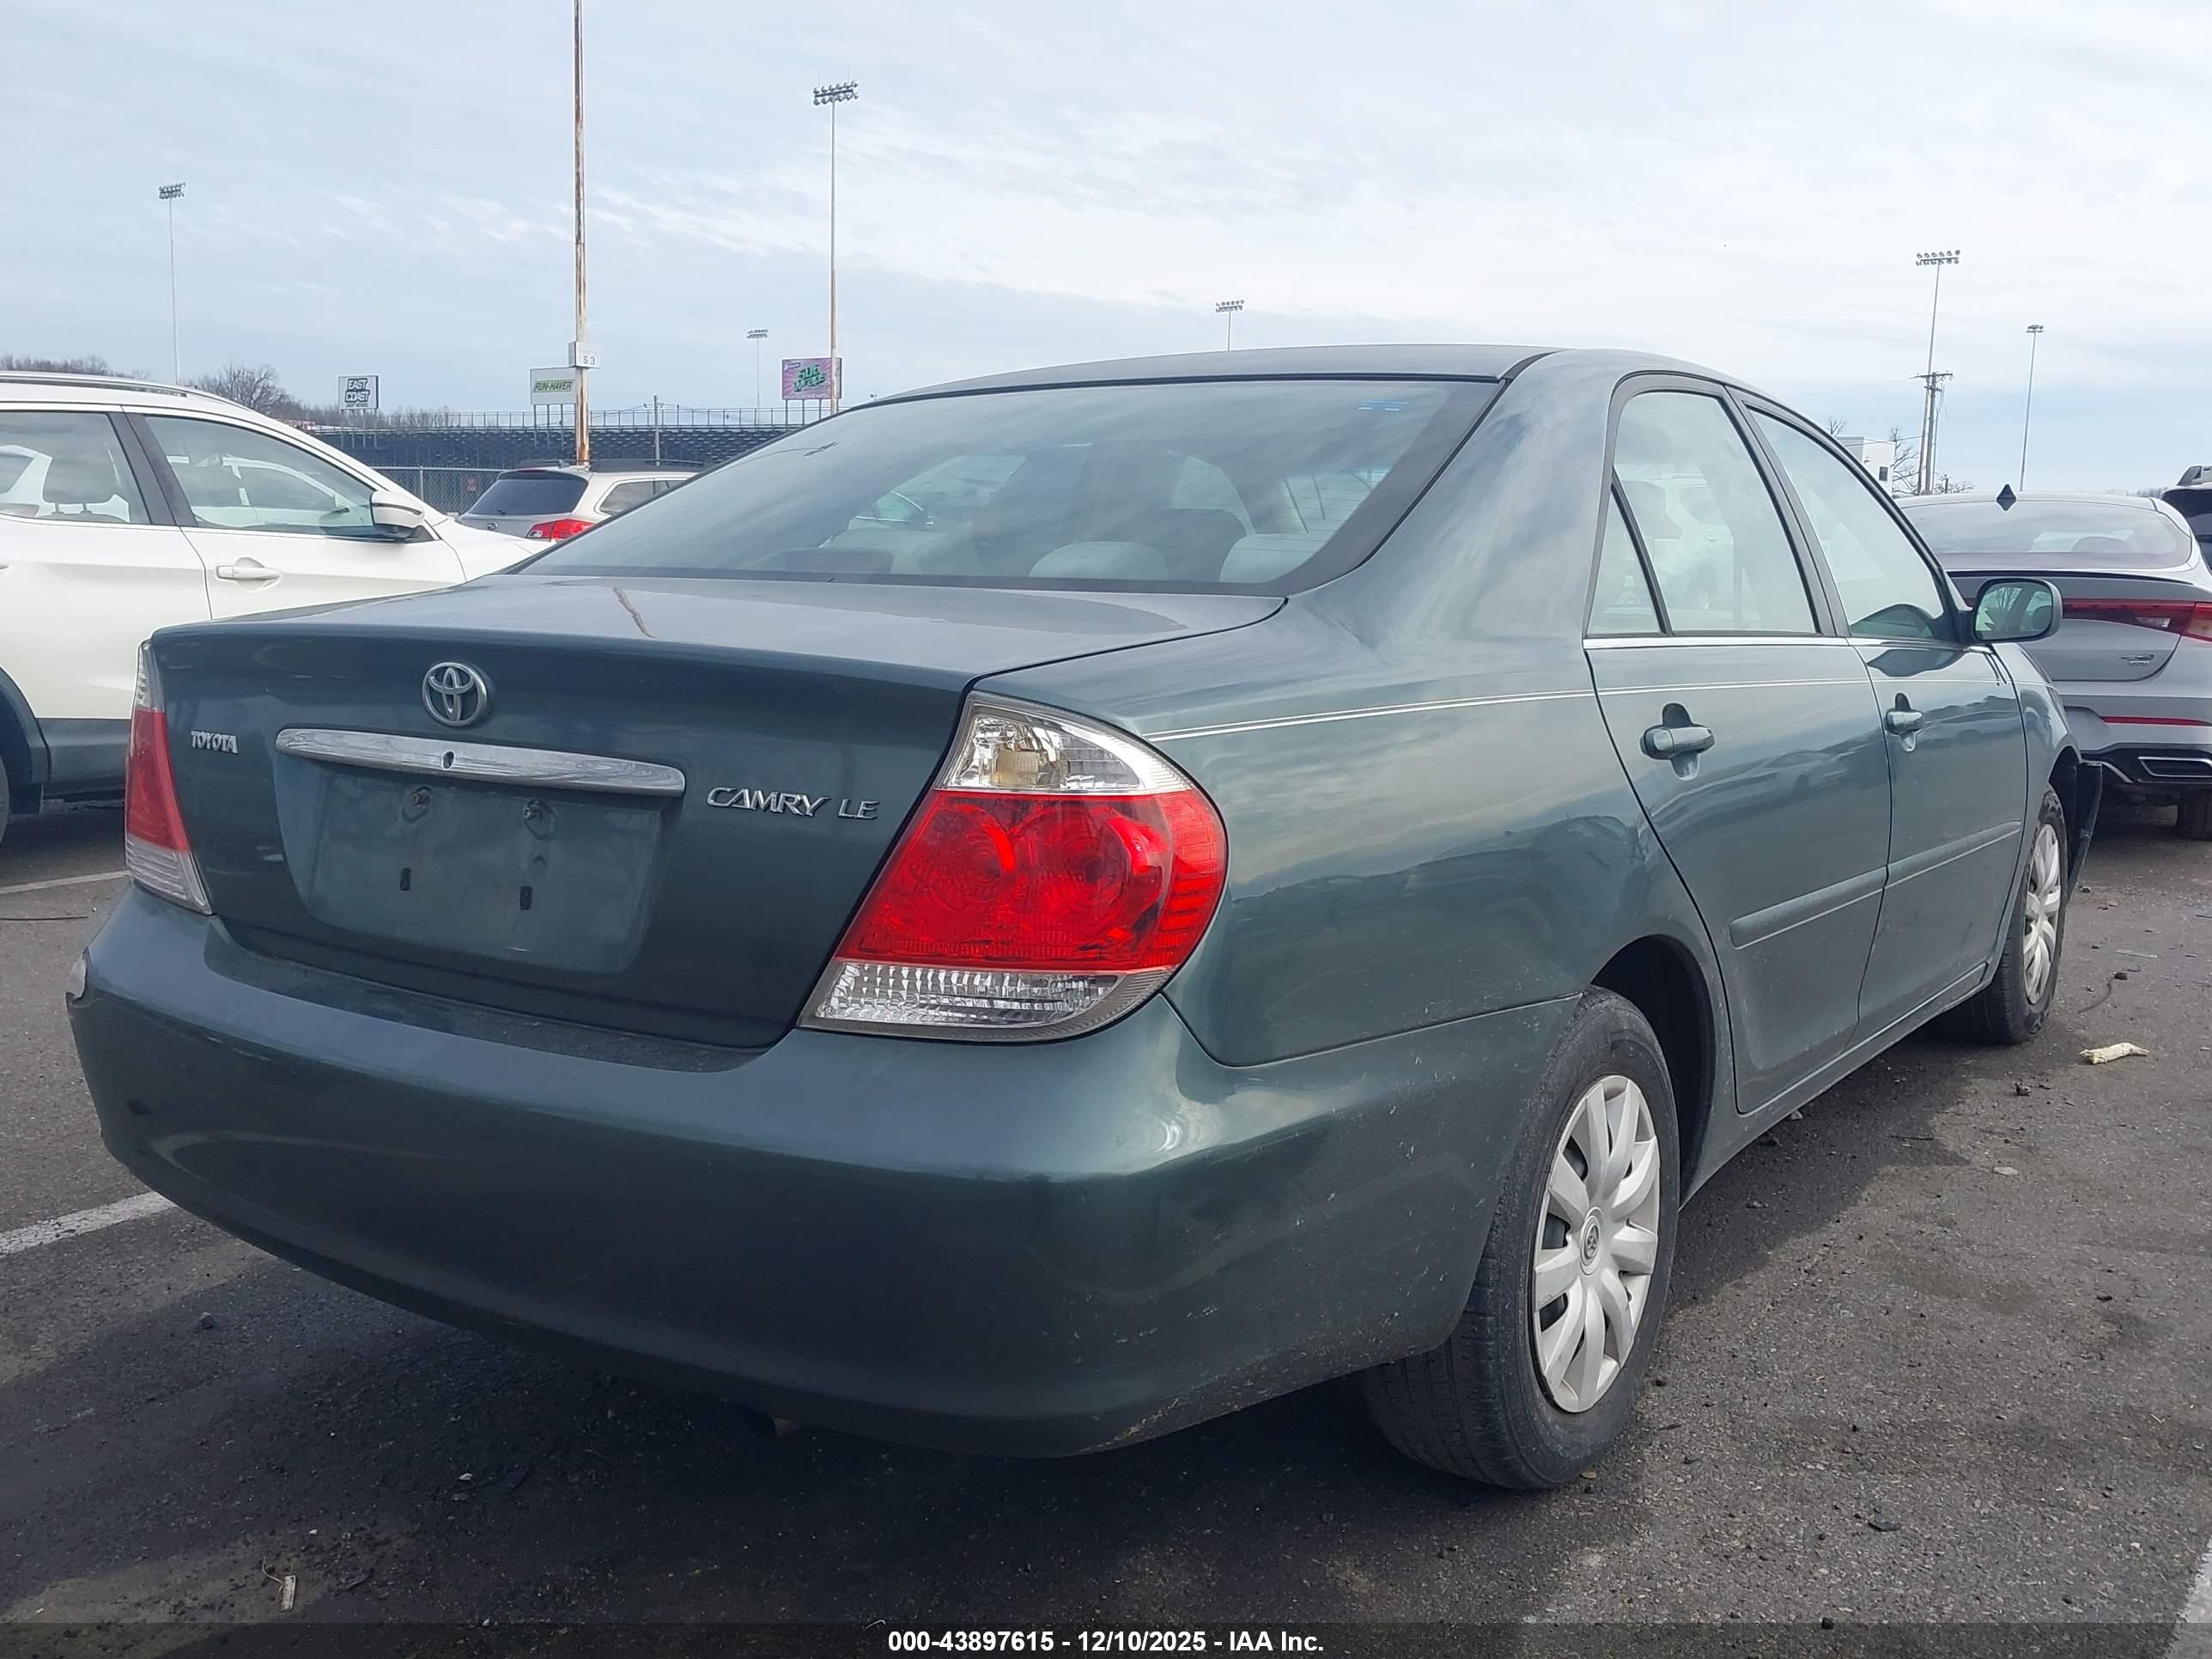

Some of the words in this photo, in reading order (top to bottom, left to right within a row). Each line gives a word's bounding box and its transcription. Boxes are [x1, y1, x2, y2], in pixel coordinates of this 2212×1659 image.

[348, 378, 368, 390] EAST
[345, 390, 370, 403] COAST
[191, 731, 238, 755] TOYOTA
[707, 787, 831, 817] CAMRY
[838, 798, 880, 820] LE
